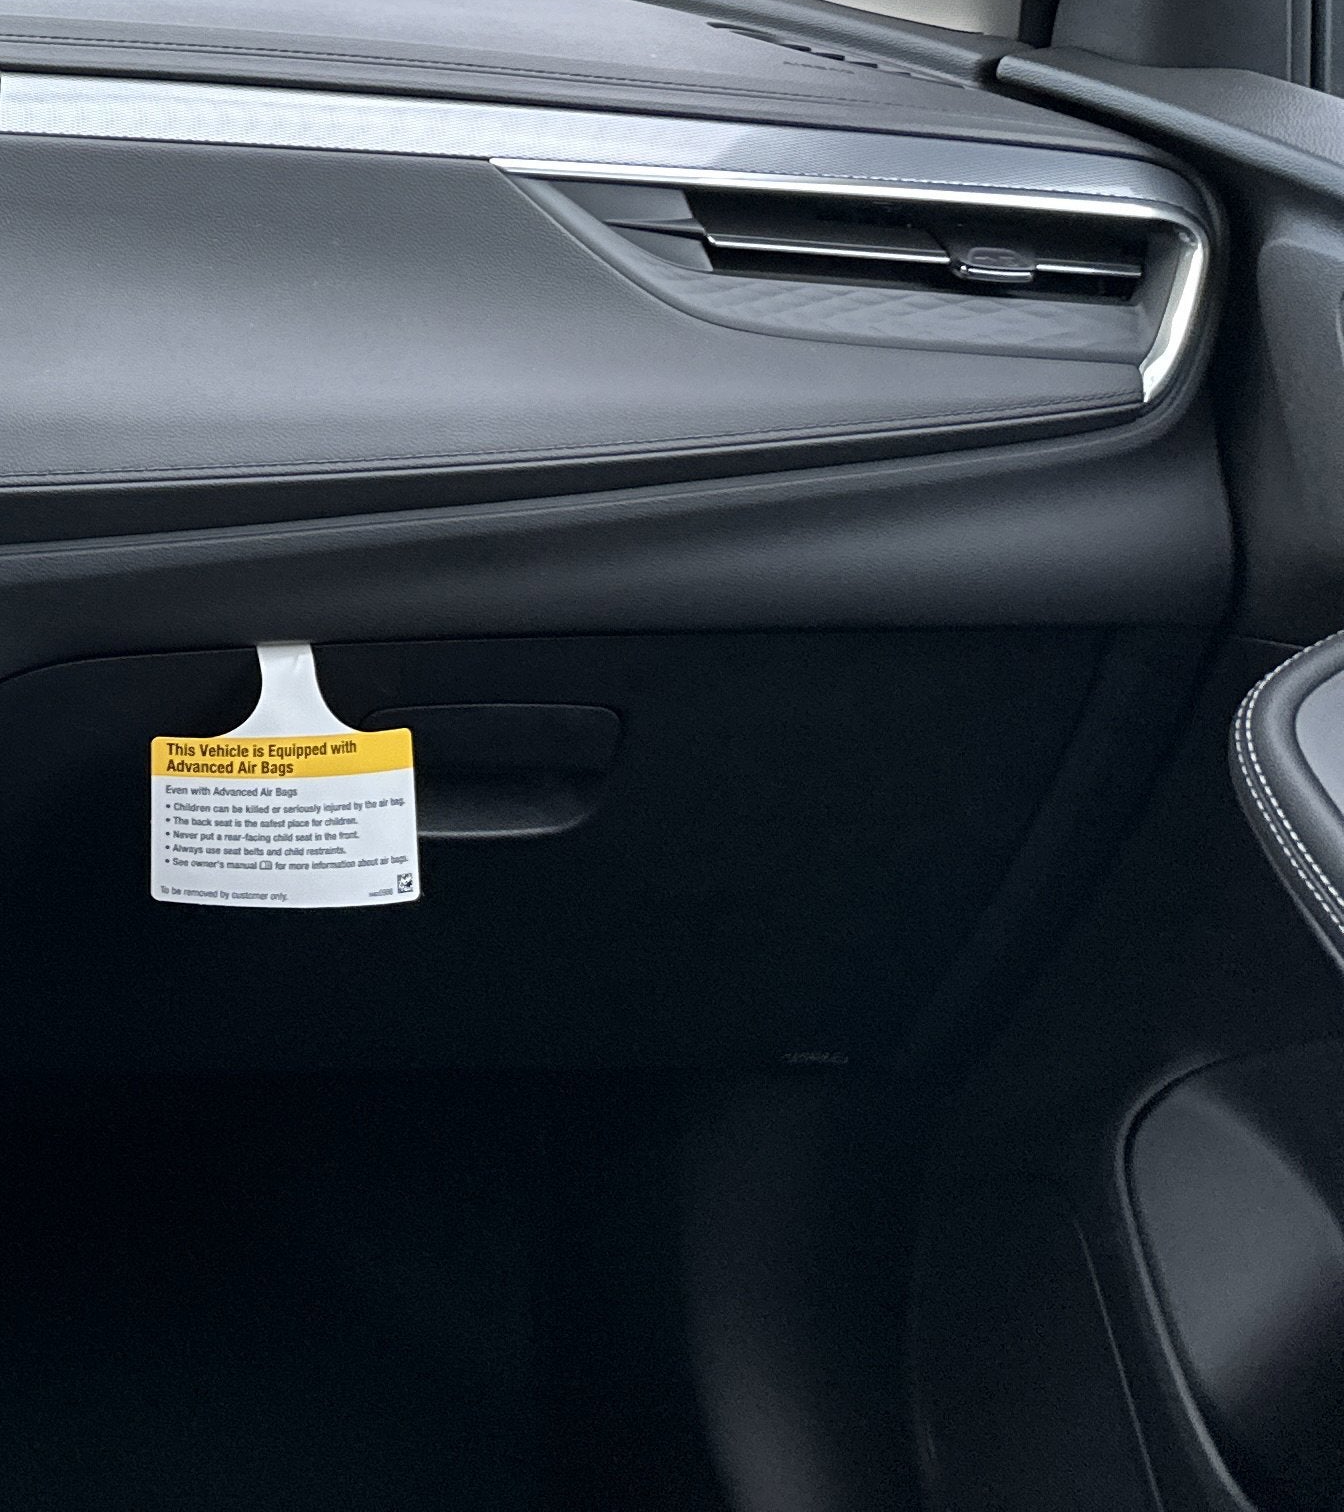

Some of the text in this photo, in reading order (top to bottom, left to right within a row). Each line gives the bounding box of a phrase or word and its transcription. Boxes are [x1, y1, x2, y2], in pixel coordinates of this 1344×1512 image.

[166, 740, 357, 760] This Vehicle is Equipped with
[166, 759, 294, 776] Advanced Air Bags
[165, 785, 297, 798] Even with Advanced Air Bags
[173, 802, 210, 813] Children
[213, 804, 229, 813] can
[232, 805, 243, 813] be
[245, 805, 269, 814] killed
[283, 804, 321, 814] seriously
[323, 802, 351, 813] injured
[354, 801, 363, 812] by
[365, 800, 377, 809] the
[379, 799, 388, 807] air
[173, 816, 358, 829] The back seat is the safest place for children.
[173, 830, 198, 840] Never
[200, 832, 214, 842] put
[224, 833, 271, 843] rear-facing
[272, 833, 293, 842] child
[295, 833, 312, 841] seat
[314, 833, 322, 841] in
[324, 832, 337, 841] the
[172, 844, 203, 854] Always
[223, 847, 241, 855] seat
[244, 847, 264, 856] belts
[266, 847, 282, 856] and
[284, 847, 304, 856] child
[306, 846, 347, 856] restraints.
[172, 857, 188, 866] See
[191, 859, 224, 869] owner's
[226, 861, 257, 870] manual
[275, 861, 286, 870] for
[288, 862, 309, 870] more
[311, 860, 356, 870] information
[357, 858, 378, 867] about
[380, 856, 389, 865] air
[160, 885, 169, 894] To
[171, 886, 181, 895] be
[183, 888, 218, 898] removed
[220, 890, 229, 900] by
[231, 891, 268, 899] customer
